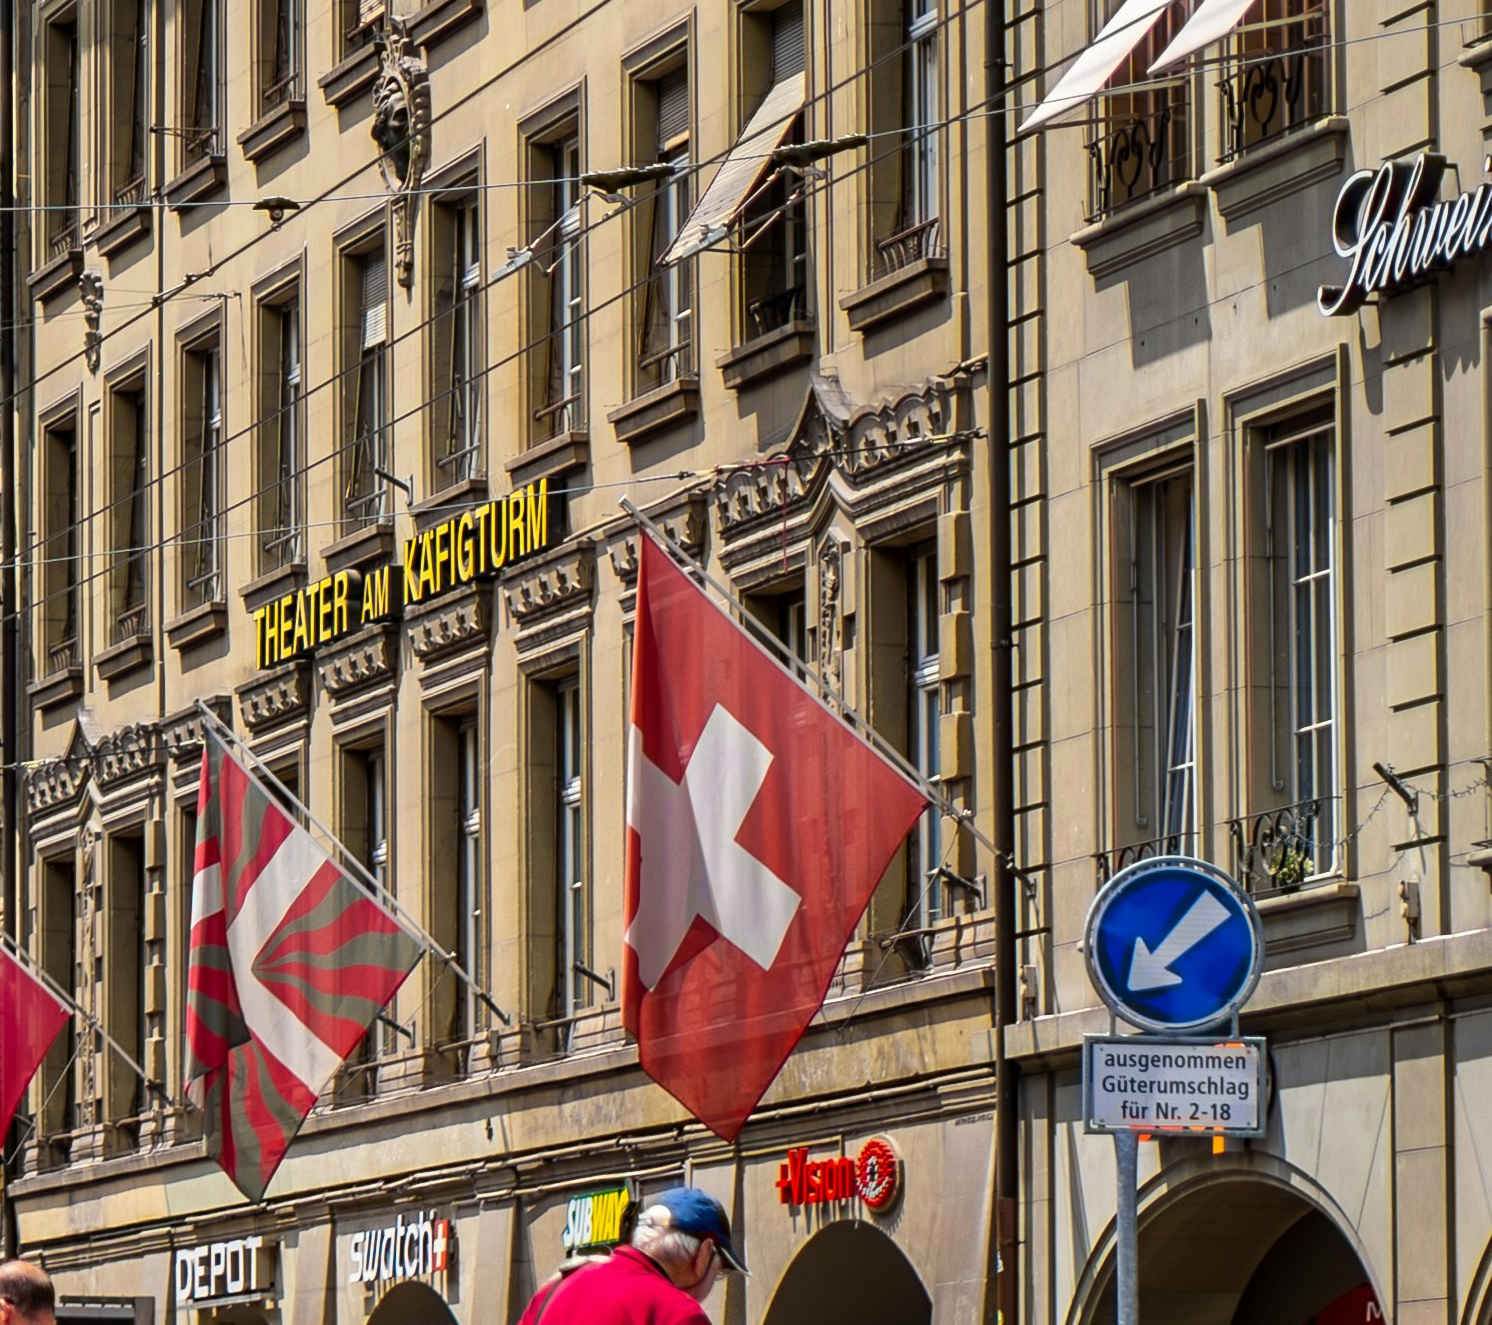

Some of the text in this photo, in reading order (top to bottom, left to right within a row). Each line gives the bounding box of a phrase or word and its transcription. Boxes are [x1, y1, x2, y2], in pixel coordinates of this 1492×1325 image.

[1317, 152, 1492, 316] Schwei
[253, 477, 549, 670] THEATER AM KÄFIGTURM
[1101, 1075, 1249, 1101] Güterumschlag
[1104, 1052, 1247, 1073] ausgenommen
[1120, 1100, 1232, 1121] für Nr. 2-18
[562, 1185, 630, 1250] SUBWAY
[175, 1235, 263, 1302] DEPOT
